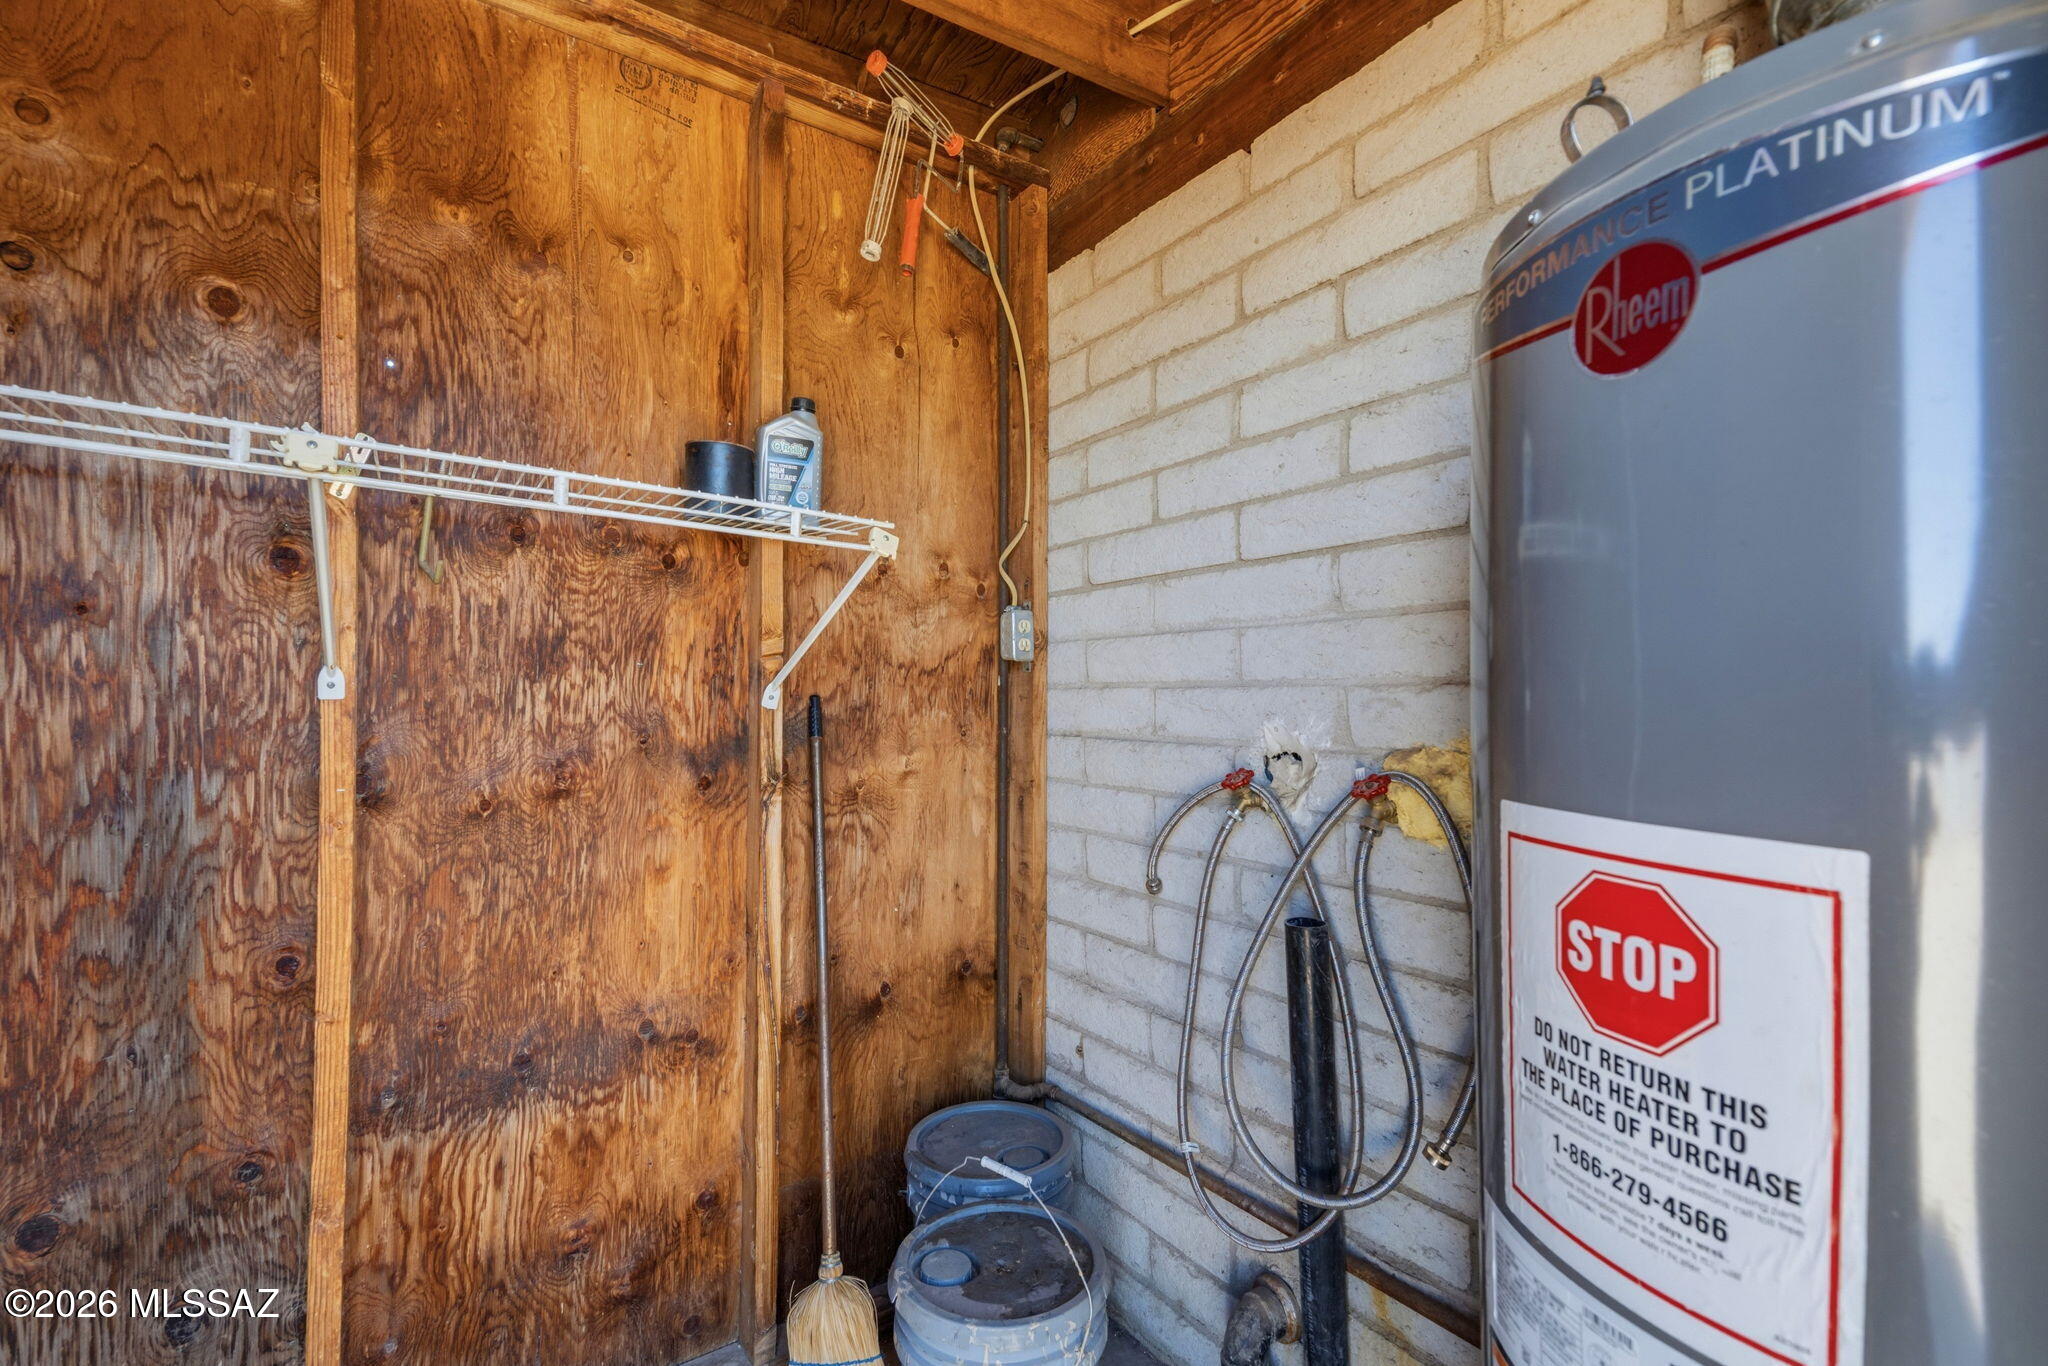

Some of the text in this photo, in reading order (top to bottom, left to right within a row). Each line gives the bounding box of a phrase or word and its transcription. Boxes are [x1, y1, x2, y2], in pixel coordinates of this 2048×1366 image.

[1482, 191, 1670, 327] PERFORMANCE
[1585, 254, 1691, 366] Rheem
[1567, 919, 1697, 1001] STOP
[1535, 1016, 1768, 1130] DO NOT RETURN THIS
[1543, 1047, 1747, 1154] WATER HEATER TO
[1521, 1058, 1802, 1207] THE PLACE OF PURCHASE
[1552, 1134, 1728, 1243] 1-866-279-4566
